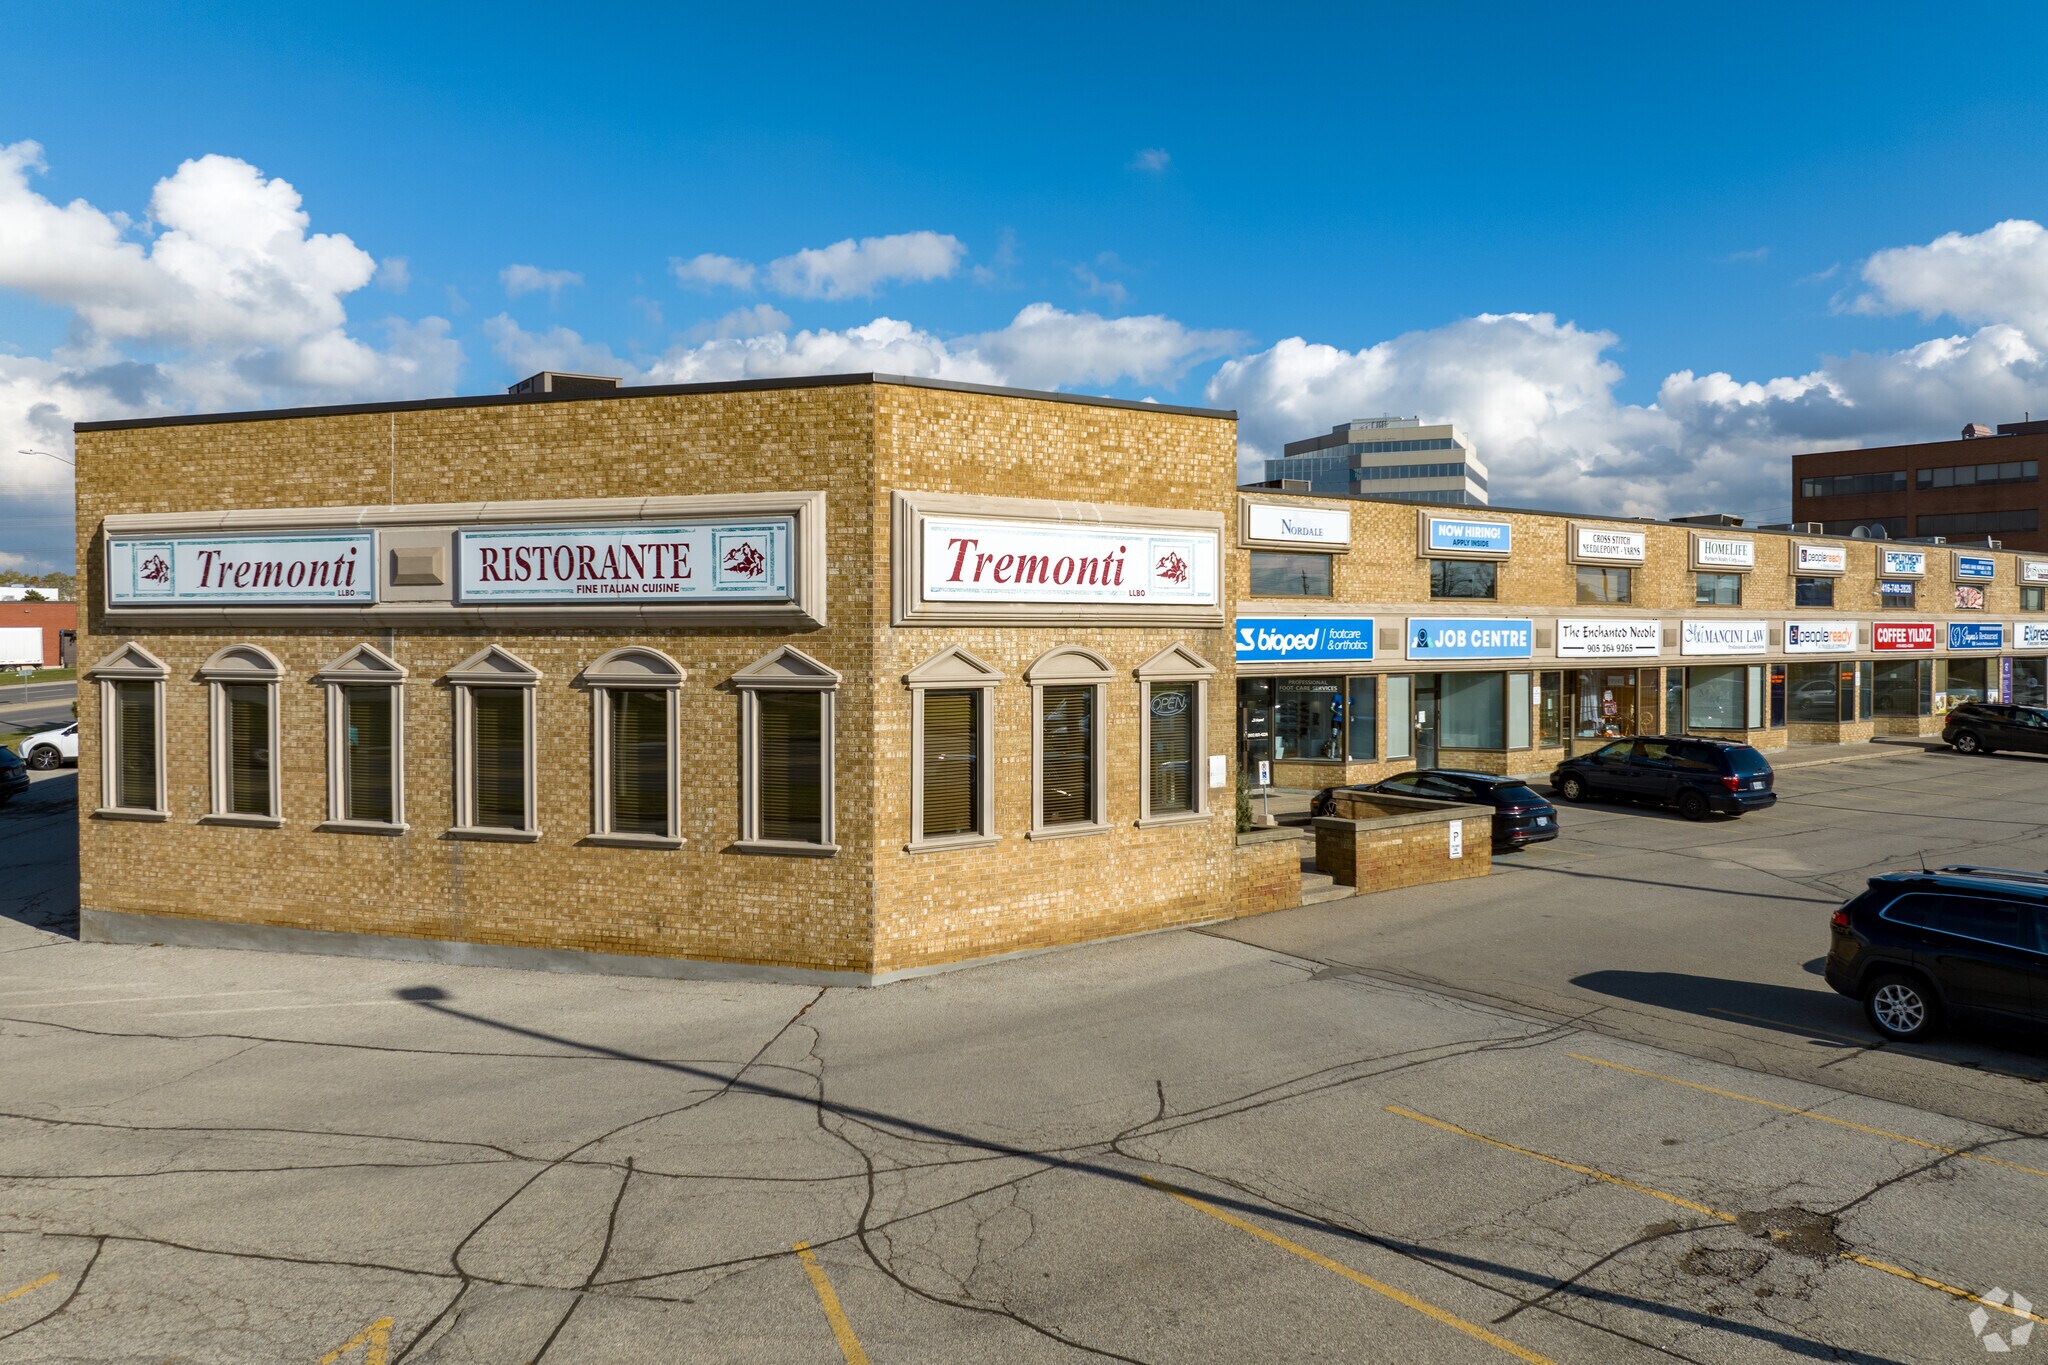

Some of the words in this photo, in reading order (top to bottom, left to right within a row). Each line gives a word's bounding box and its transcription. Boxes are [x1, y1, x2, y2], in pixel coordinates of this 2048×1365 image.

[1439, 525, 1464, 537] NOW
[1465, 526, 1501, 539] HIRING!
[1593, 534, 1611, 544] CROSS
[1612, 535, 1631, 545] STITCH
[1583, 543, 1619, 554] NEEDLEPOINT
[1624, 547, 1641, 555] YARNS
[479, 543, 692, 582] RISTORANTE
[946, 538, 1126, 587] Tremonti
[1808, 552, 1843, 564] peopleready
[1887, 553, 1922, 564] EMPLOYMENT
[197, 546, 357, 589] Tremonti
[1895, 560, 1916, 572] CENTRE
[576, 584, 598, 594] FINE
[600, 583, 639, 594] ITALIAN
[642, 583, 680, 593] CUISINE
[1128, 589, 1146, 597] LLBO
[1563, 625, 1580, 638] The
[1582, 625, 1628, 638] Enchanted
[1630, 625, 1656, 638] Needle
[1705, 630, 1742, 643] MANCINI
[1746, 630, 1765, 643] LAW
[1800, 627, 1852, 647] peopleready
[1878, 628, 1906, 642] COFFEE
[1908, 628, 1932, 642] YILDIZ
[1257, 628, 1320, 655] bioped
[1329, 628, 1361, 639] footcare
[1435, 630, 1467, 648] JOB
[1471, 630, 1527, 648] CENTRE
[1586, 644, 1600, 652] 905
[1602, 644, 1614, 652] 264
[1616, 644, 1634, 652] 9265
[1153, 696, 1186, 710] OPEN
